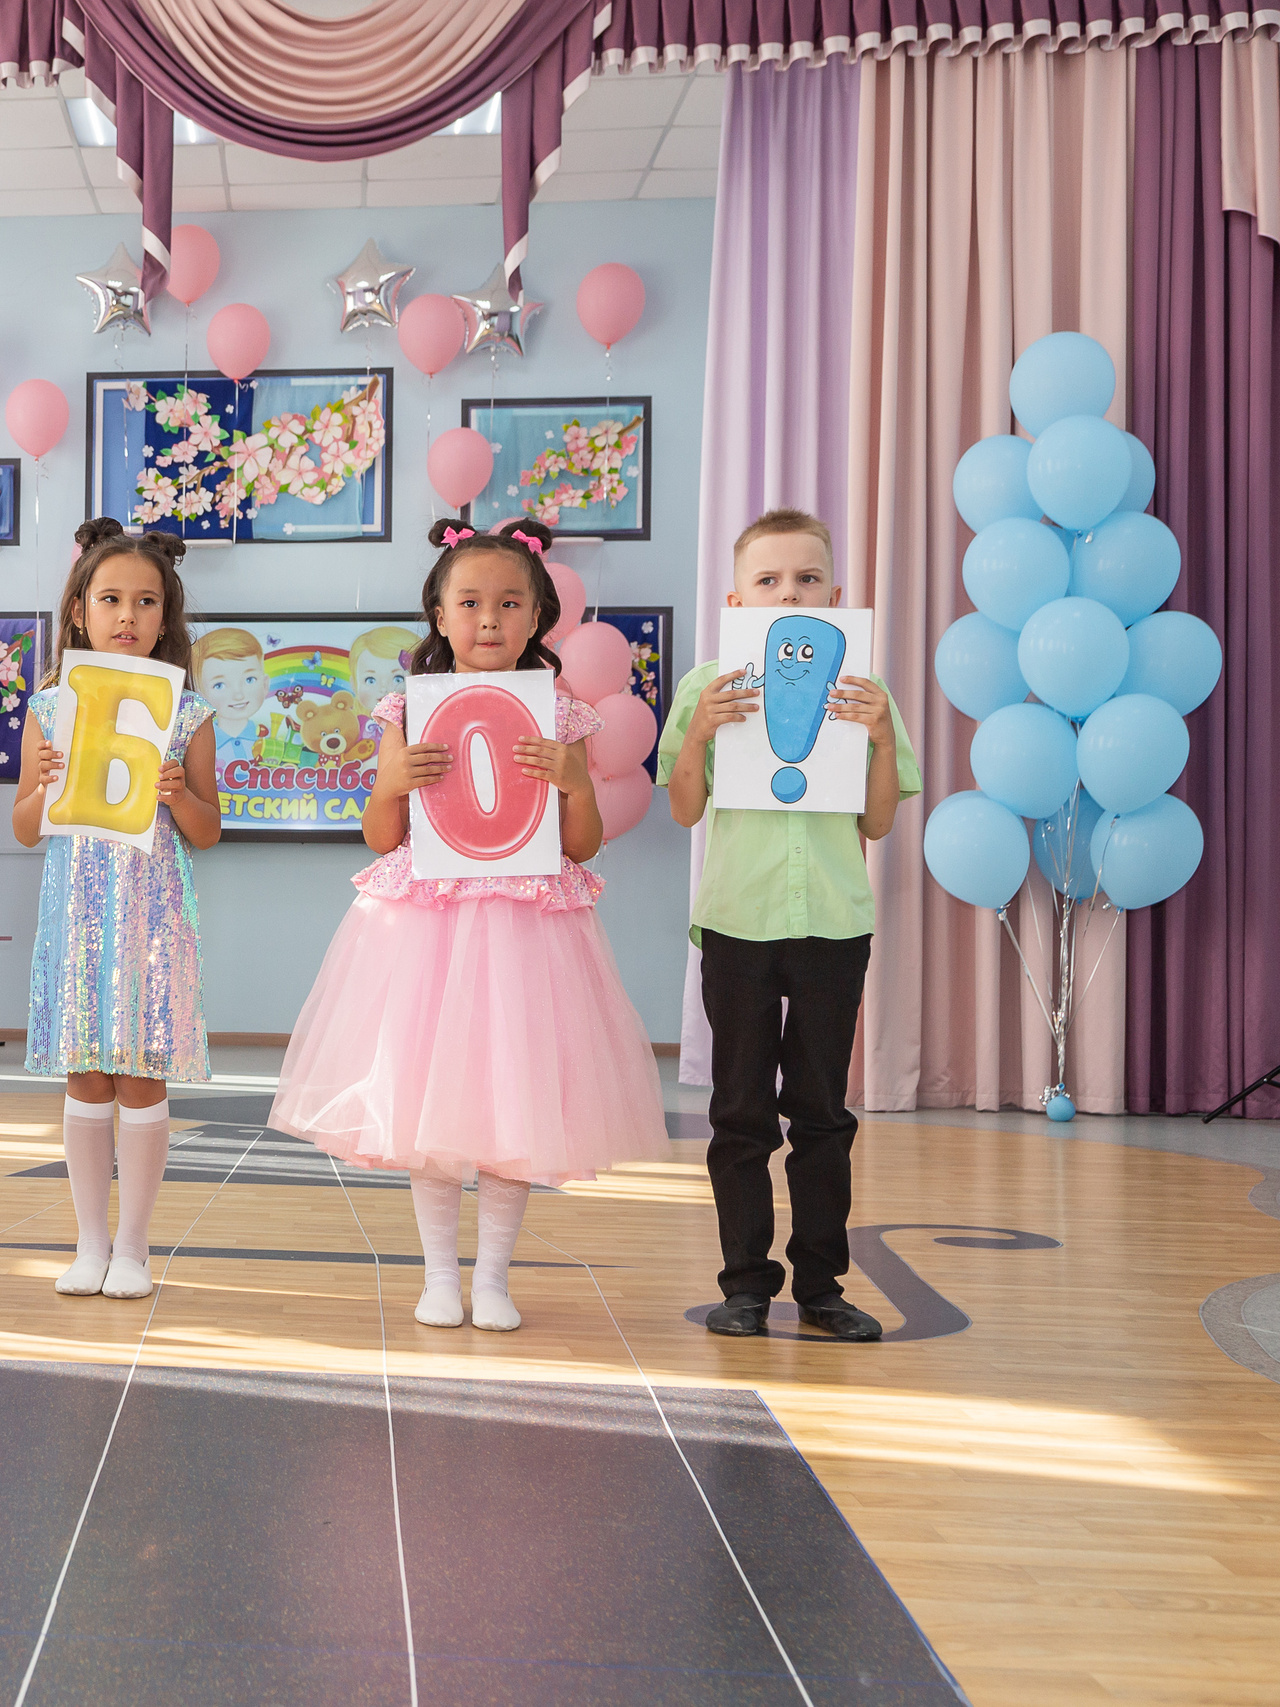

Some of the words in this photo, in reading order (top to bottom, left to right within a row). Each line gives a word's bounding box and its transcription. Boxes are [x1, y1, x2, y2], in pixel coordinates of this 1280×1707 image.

[48, 665, 173, 835] Б
[223, 759, 378, 790] Спасибо
[218, 791, 318, 820] ЕТСКИЙ
